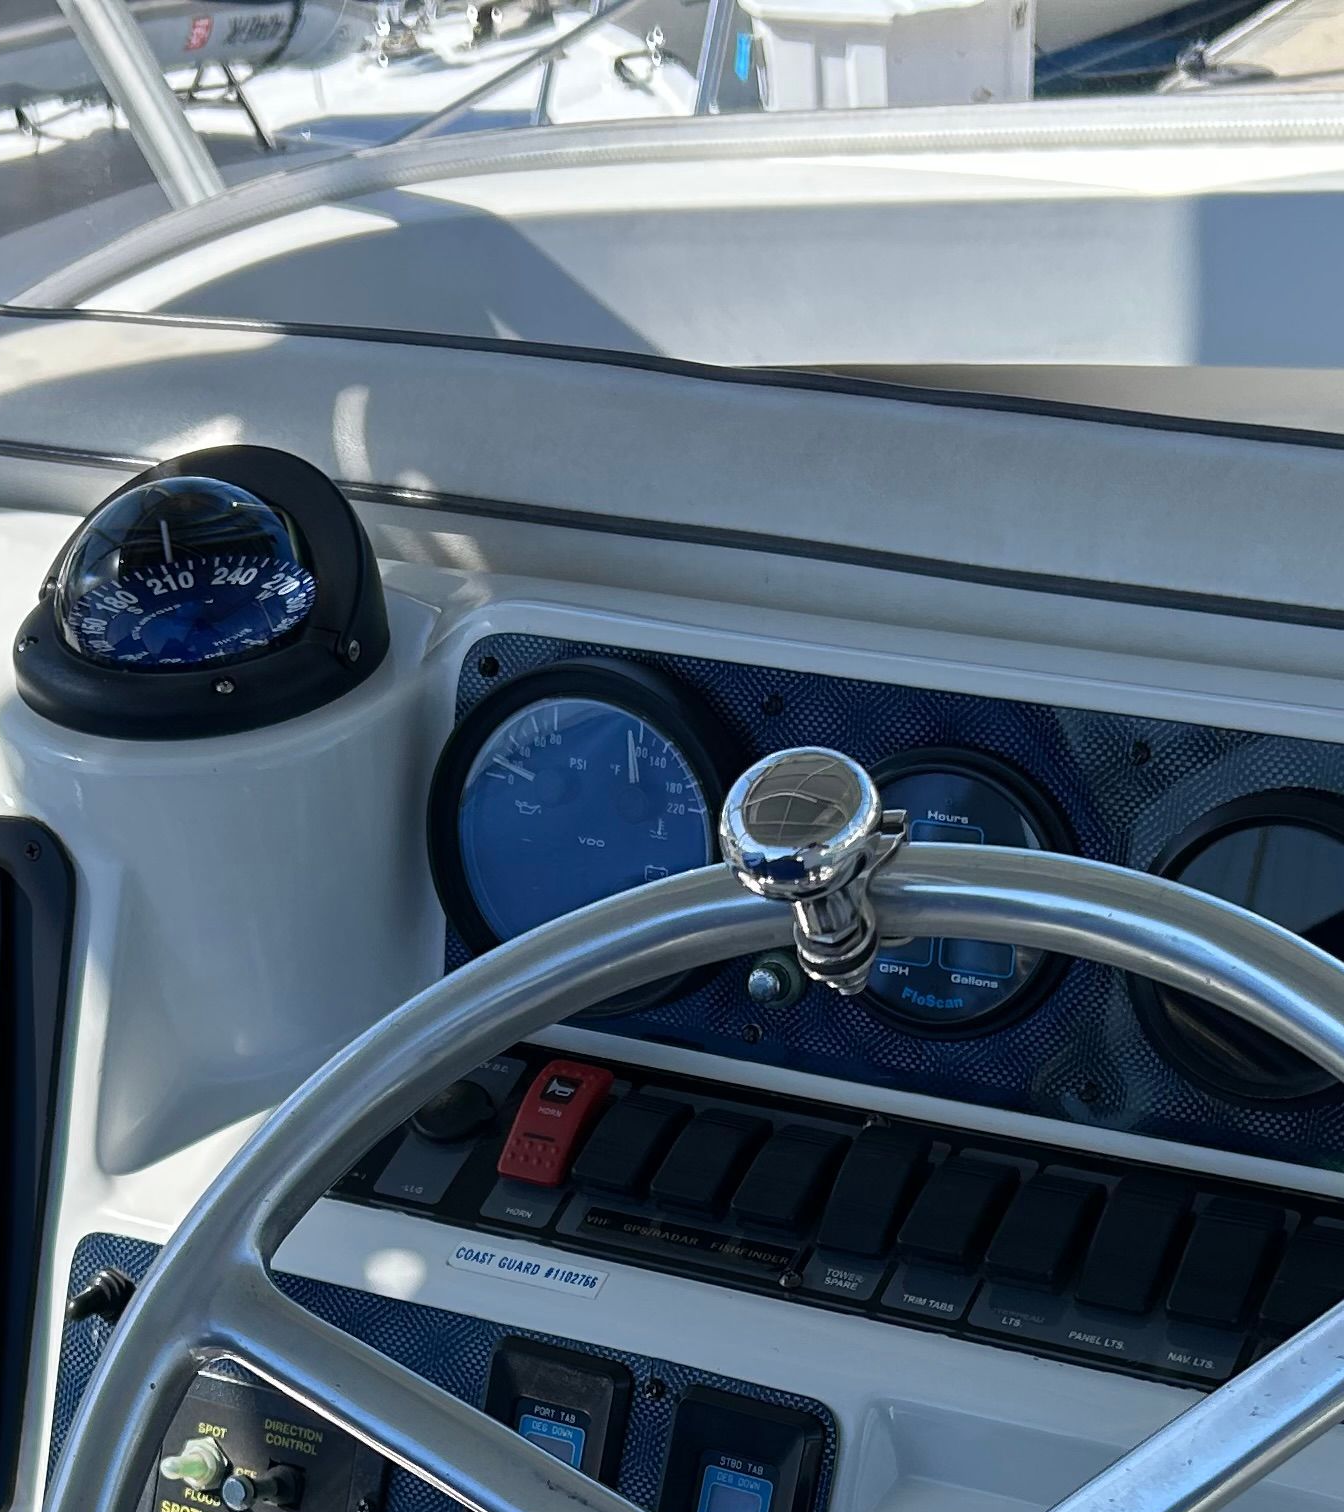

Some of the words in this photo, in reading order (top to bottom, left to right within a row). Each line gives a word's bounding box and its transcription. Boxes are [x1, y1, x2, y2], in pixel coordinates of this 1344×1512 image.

[146, 571, 194, 596] 210
[211, 567, 257, 585] 240
[262, 573, 300, 596] 270
[95, 590, 139, 614] 180
[550, 734, 562, 745] 80
[570, 758, 587, 770] PSI
[666, 782, 682, 794] 180
[667, 803, 685, 815] 220
[928, 810, 969, 824] Hours
[578, 837, 605, 847] VDO
[879, 964, 909, 976] GPH
[951, 974, 998, 989] Gallons
[901, 987, 963, 1009] FloScan
[538, 1106, 561, 1118] HORN
[505, 1207, 532, 1218] HORN
[456, 1247, 494, 1264] COAST
[498, 1255, 540, 1275] GUARD
[824, 1277, 857, 1290] SPARE
[902, 1294, 926, 1308] TRIM
[929, 1300, 954, 1313] TABS
[1069, 1331, 1102, 1347] PANEL
[534, 1405, 555, 1418] PORT
[560, 1412, 576, 1424] TAB
[198, 1422, 227, 1439] SPOT
[264, 1418, 323, 1442] DIRECTION
[552, 1426, 573, 1438] DOWN
[265, 1433, 317, 1455] CONTROL
[720, 1456, 742, 1470] STBD
[748, 1463, 763, 1476] TAB
[738, 1476, 760, 1490] DOWN
[185, 1488, 221, 1506] FLOOD
